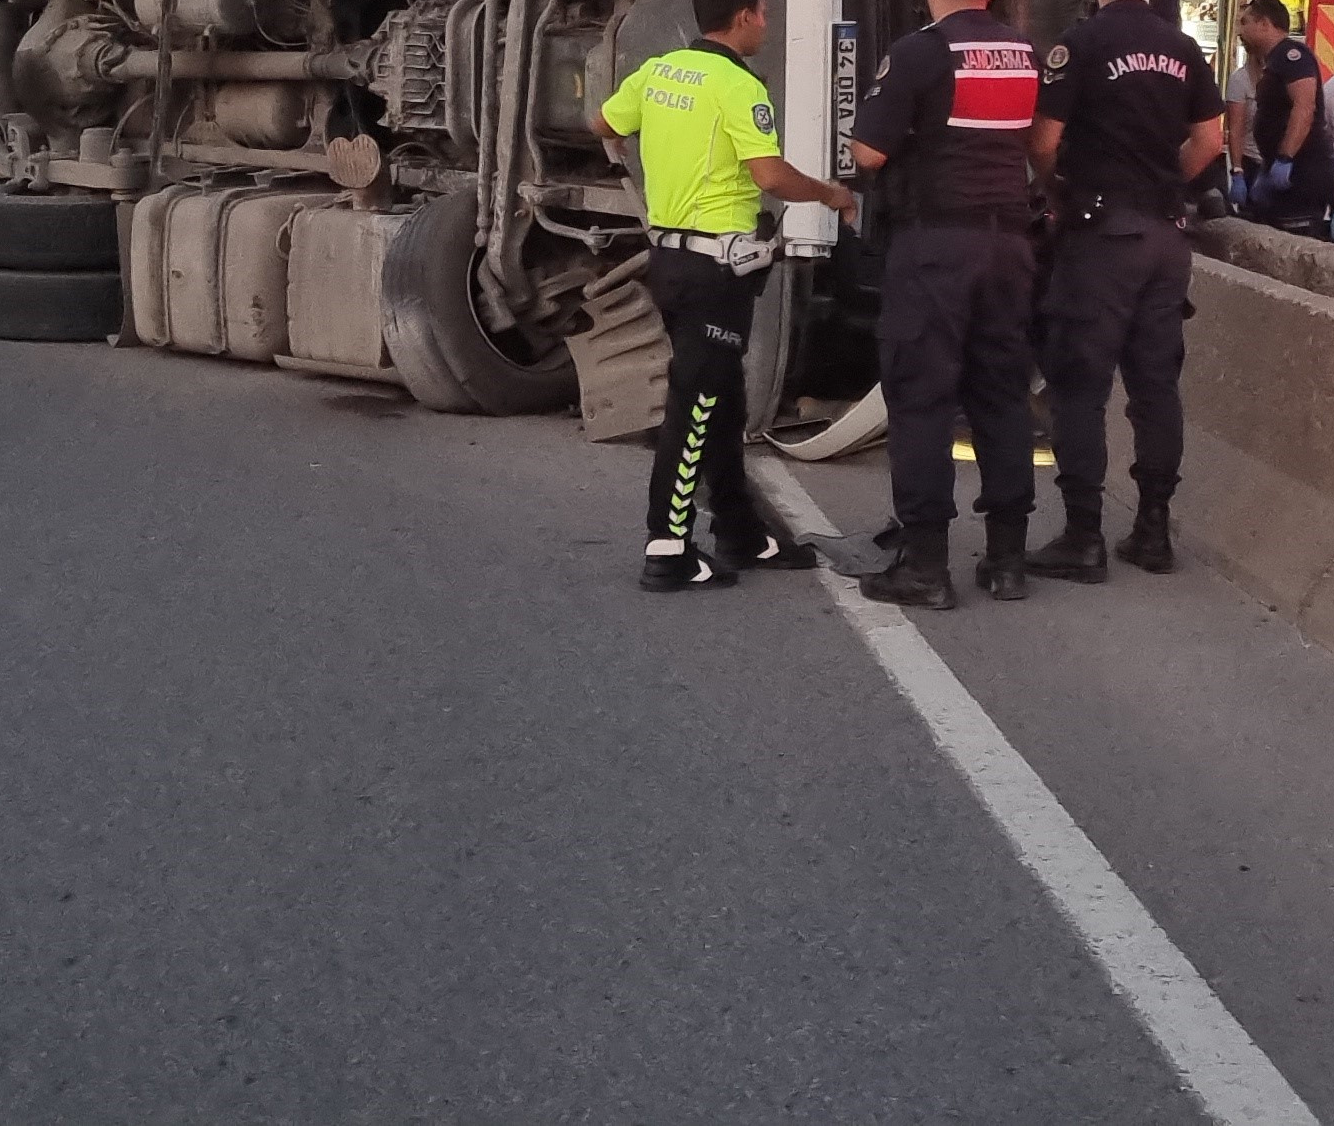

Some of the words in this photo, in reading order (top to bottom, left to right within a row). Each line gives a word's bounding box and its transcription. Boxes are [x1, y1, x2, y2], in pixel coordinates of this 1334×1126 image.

[839, 41, 854, 68] 34
[963, 49, 1033, 70] JANDARMA
[1106, 52, 1188, 83] JANDARMA
[838, 76, 854, 120] DRA
